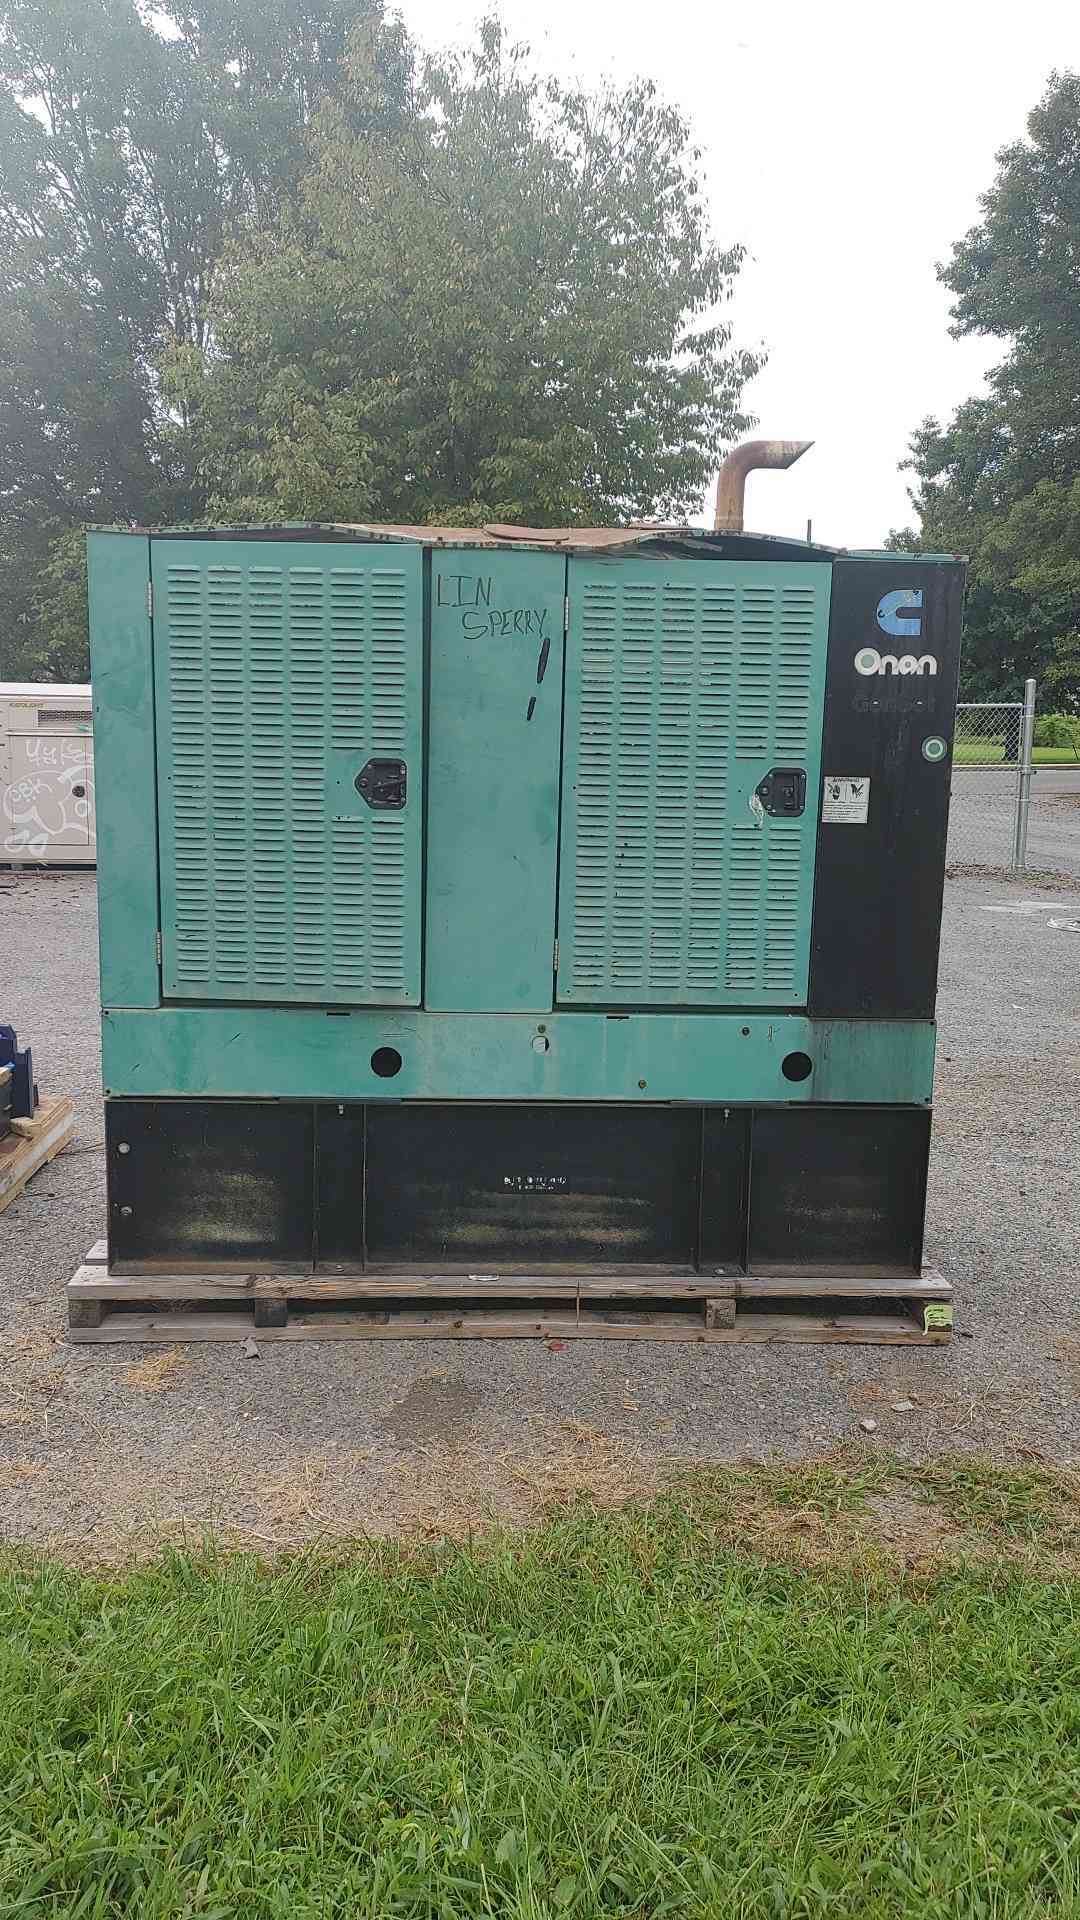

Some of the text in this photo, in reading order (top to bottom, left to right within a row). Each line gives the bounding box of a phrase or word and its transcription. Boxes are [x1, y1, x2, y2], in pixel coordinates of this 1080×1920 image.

[437, 574, 492, 607] LIN
[462, 608, 548, 640] SPERRY
[854, 647, 938, 676] Onan
